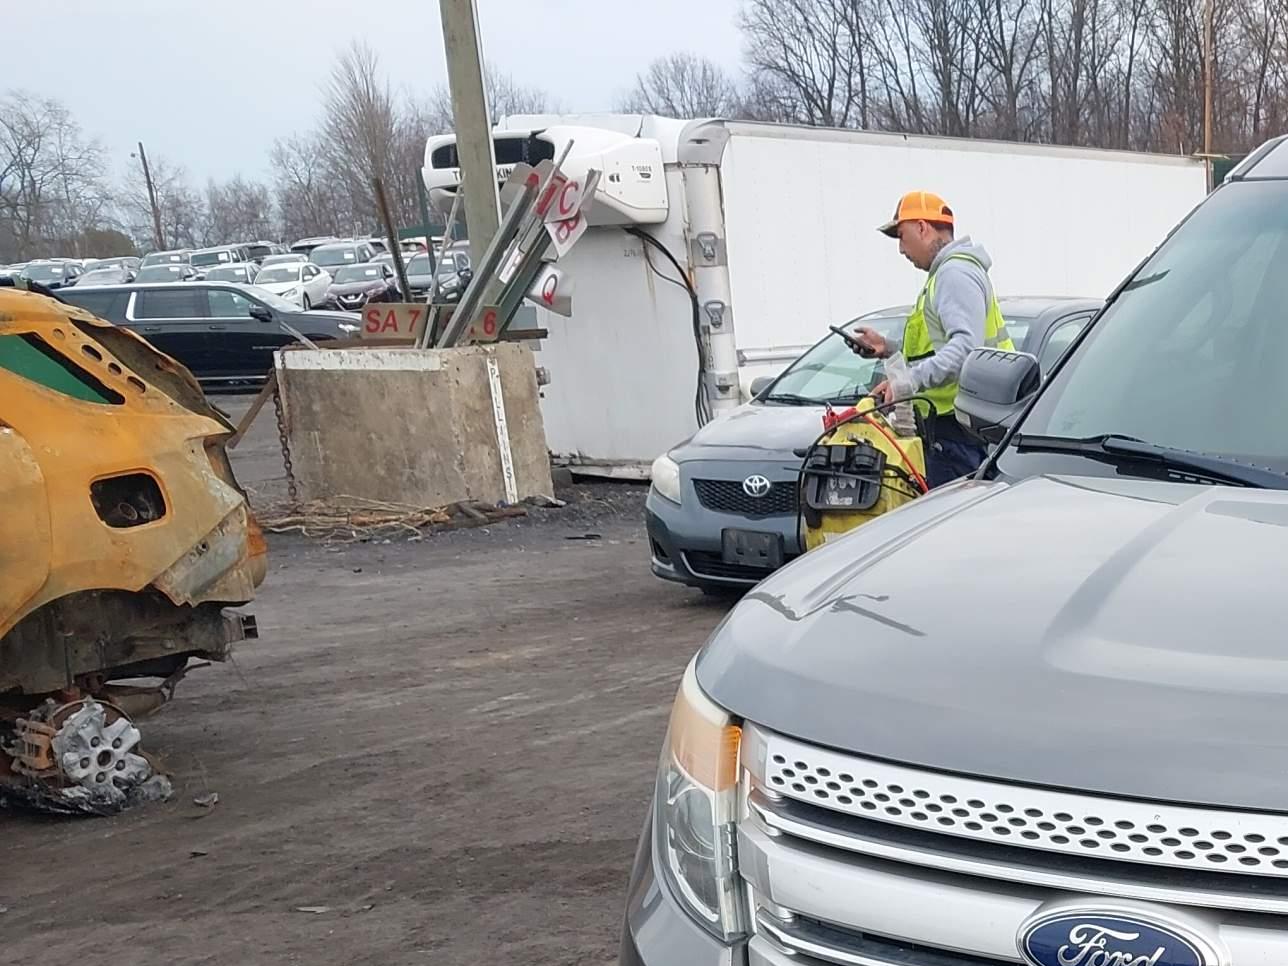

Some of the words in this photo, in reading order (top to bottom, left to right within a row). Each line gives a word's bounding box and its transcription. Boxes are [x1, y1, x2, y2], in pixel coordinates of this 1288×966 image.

[559, 180, 579, 216] C
[542, 273, 557, 306] Q
[366, 309, 398, 333] SA
[408, 309, 420, 332] 7
[483, 311, 497, 335] 6
